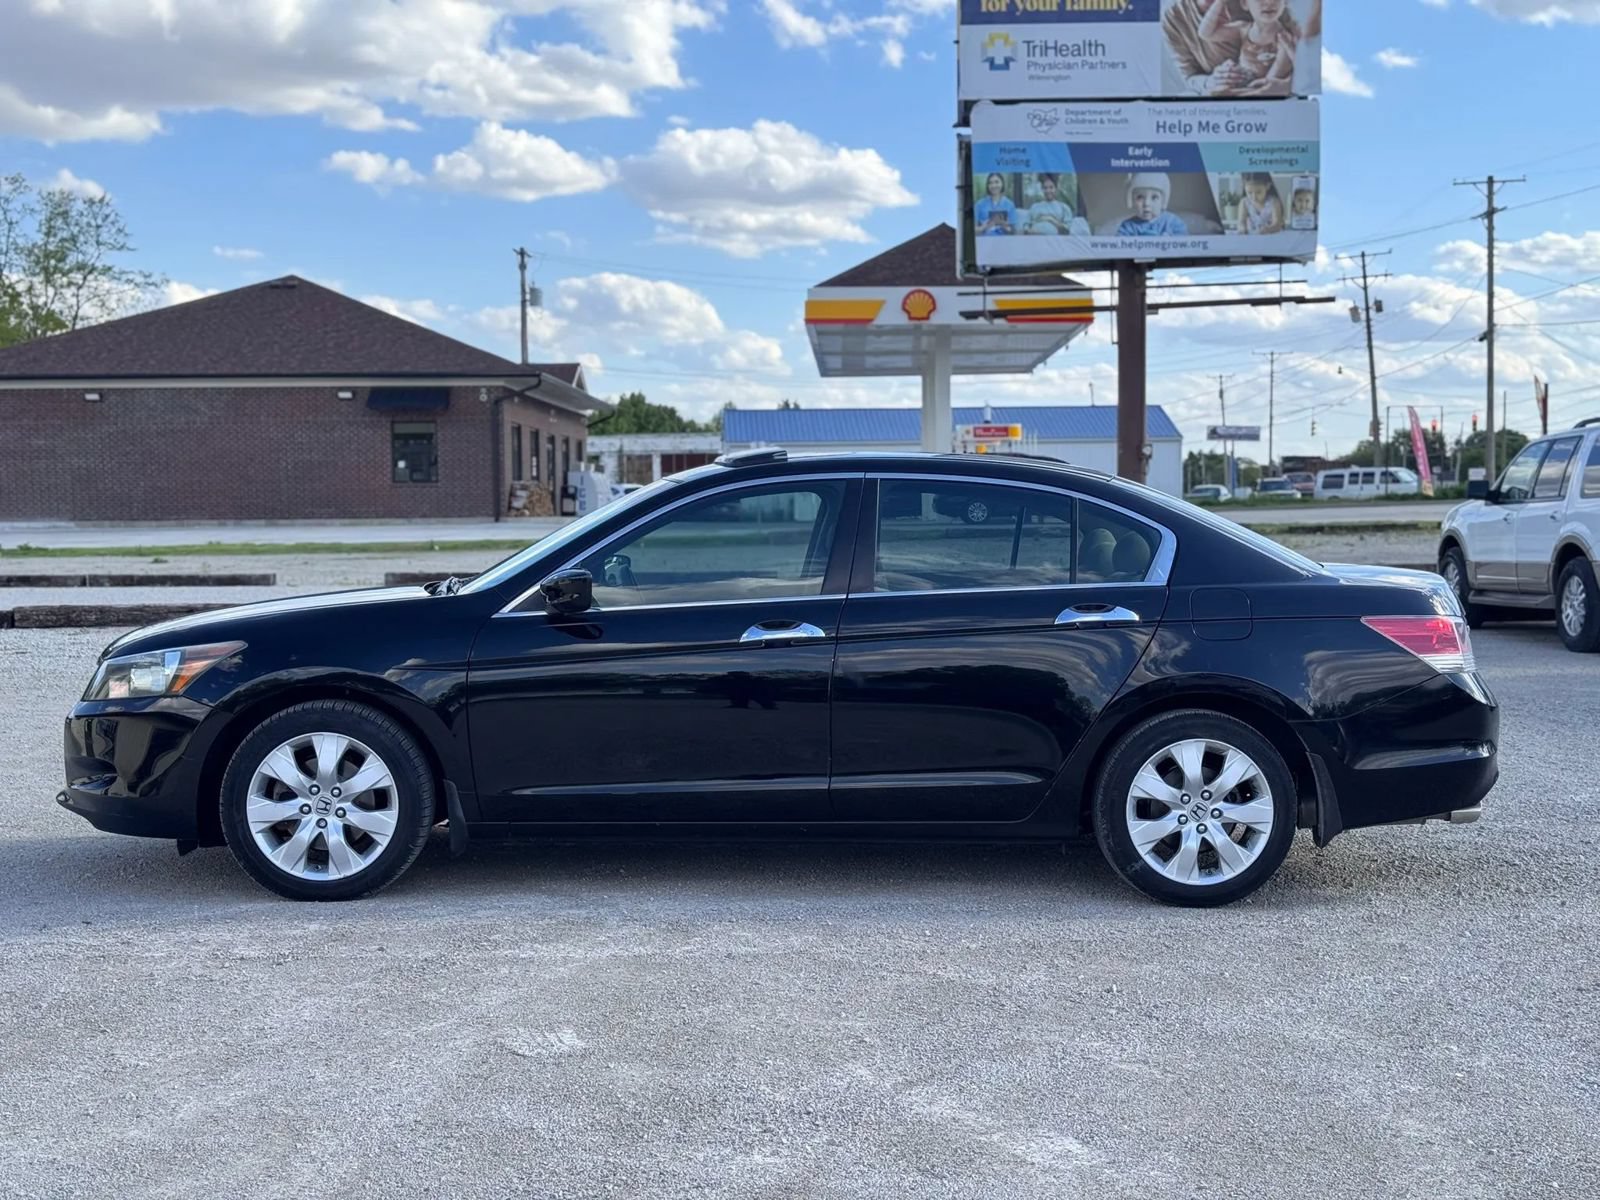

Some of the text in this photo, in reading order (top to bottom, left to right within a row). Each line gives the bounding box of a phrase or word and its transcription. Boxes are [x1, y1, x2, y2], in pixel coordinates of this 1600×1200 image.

[980, 0, 1134, 15] for your family.
[1023, 40, 1107, 58] TriHealth
[1026, 60, 1128, 72] Physician Partners
[1065, 107, 1122, 117] Department of
[1147, 108, 1162, 116] The
[1165, 108, 1187, 116] heart
[1189, 107, 1197, 116] of
[1199, 107, 1231, 118] thriving
[1065, 117, 1129, 125] Children & Youth
[1155, 119, 1268, 136] Help Me Grow
[999, 147, 1027, 155] Home
[1128, 145, 1153, 158] Early
[1239, 145, 1309, 156] Developmental
[995, 157, 1031, 168] Visiting
[1110, 157, 1170, 167] Intervention
[1248, 157, 1298, 167] Screenings
[1090, 238, 1209, 251] www.helpmegrow.org
